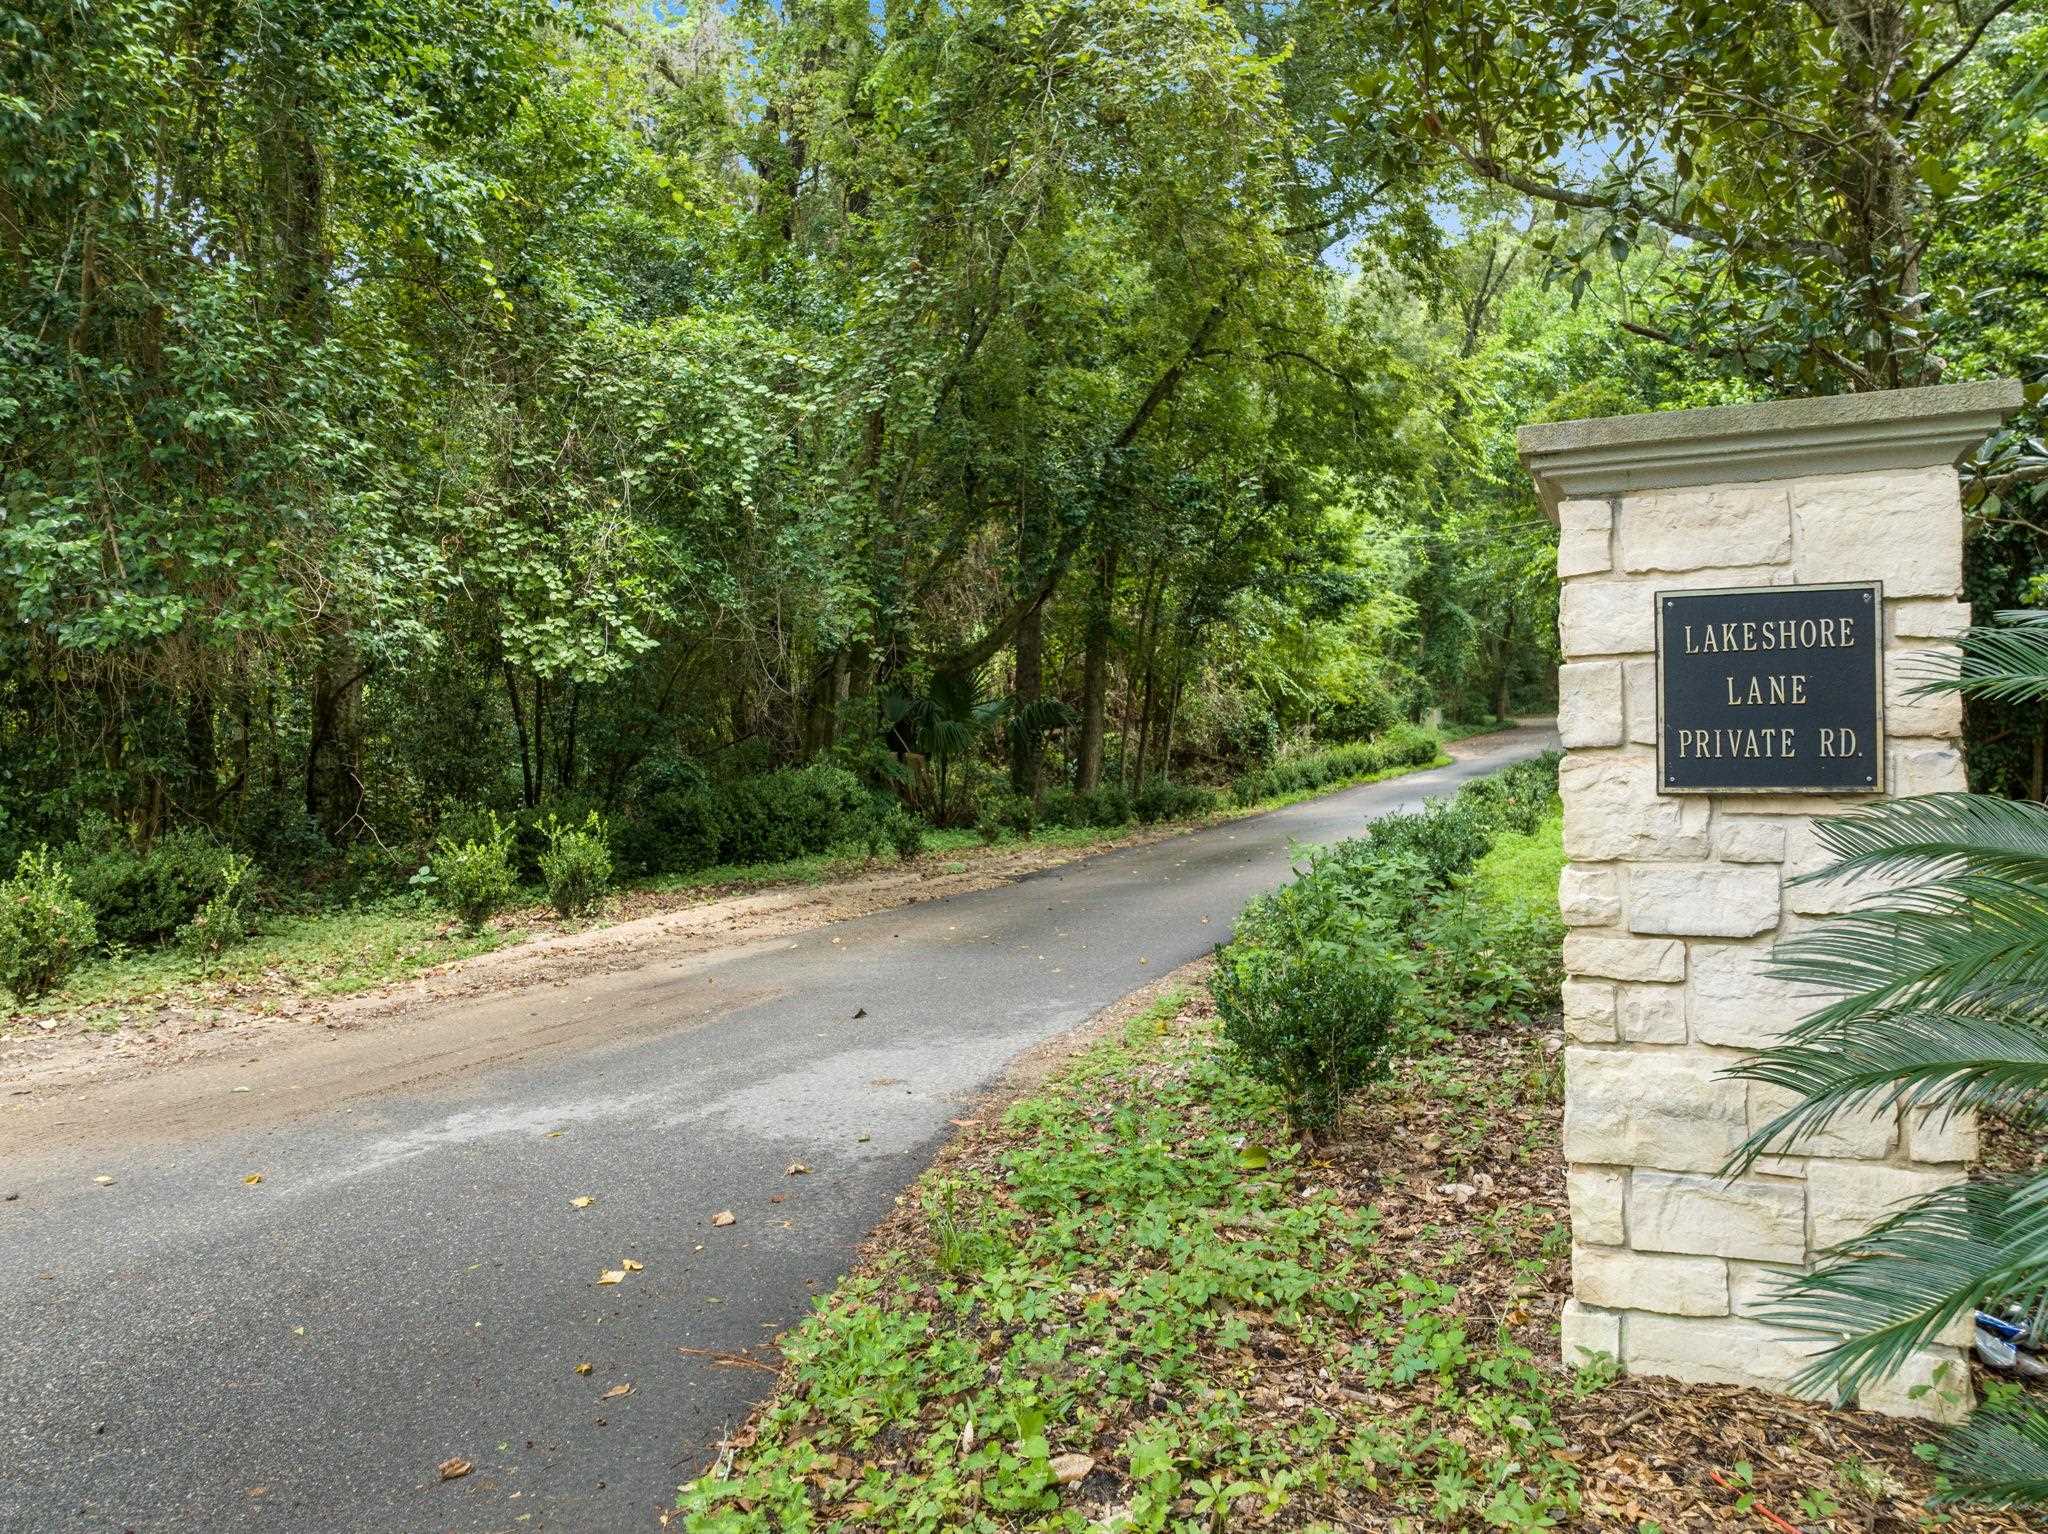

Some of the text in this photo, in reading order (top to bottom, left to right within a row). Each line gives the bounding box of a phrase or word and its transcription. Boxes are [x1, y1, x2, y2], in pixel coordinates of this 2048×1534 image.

[1685, 618, 1855, 654] LAKESHORE
[1726, 675, 1807, 705] LANE
[1679, 728, 1863, 758] PRIVATE RD.
